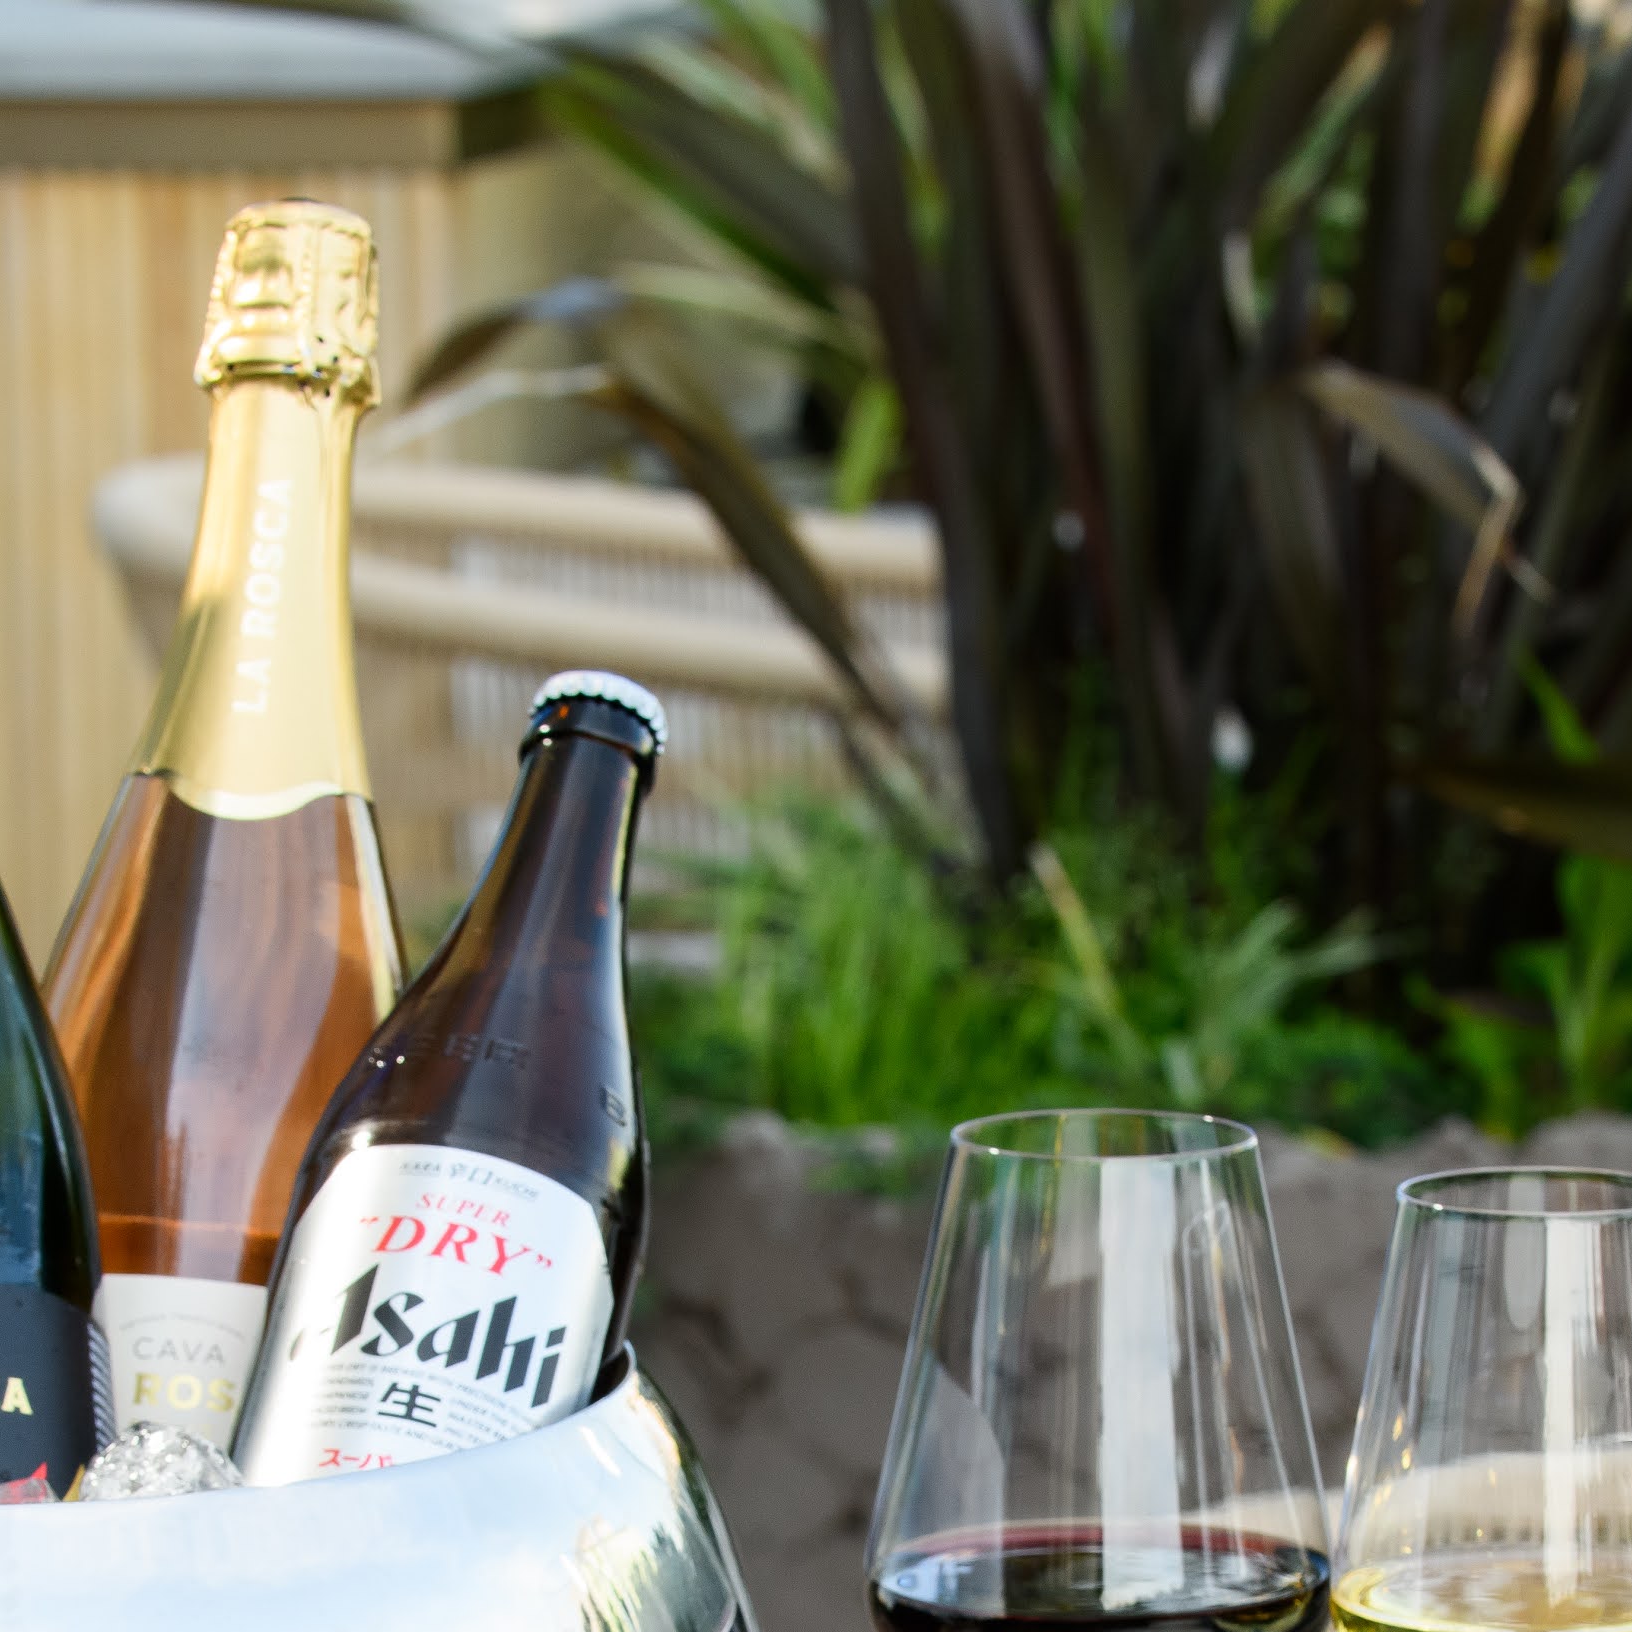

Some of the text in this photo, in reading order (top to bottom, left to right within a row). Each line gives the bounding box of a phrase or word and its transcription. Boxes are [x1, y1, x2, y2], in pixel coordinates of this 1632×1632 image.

[231, 476, 296, 716] LA ROSCA
[416, 1191, 512, 1228] SUPER
[132, 1336, 226, 1368] CAVA
[289, 1262, 567, 1410] Asahi
[132, 1371, 237, 1413] ROS
[377, 1382, 442, 1427] 生
